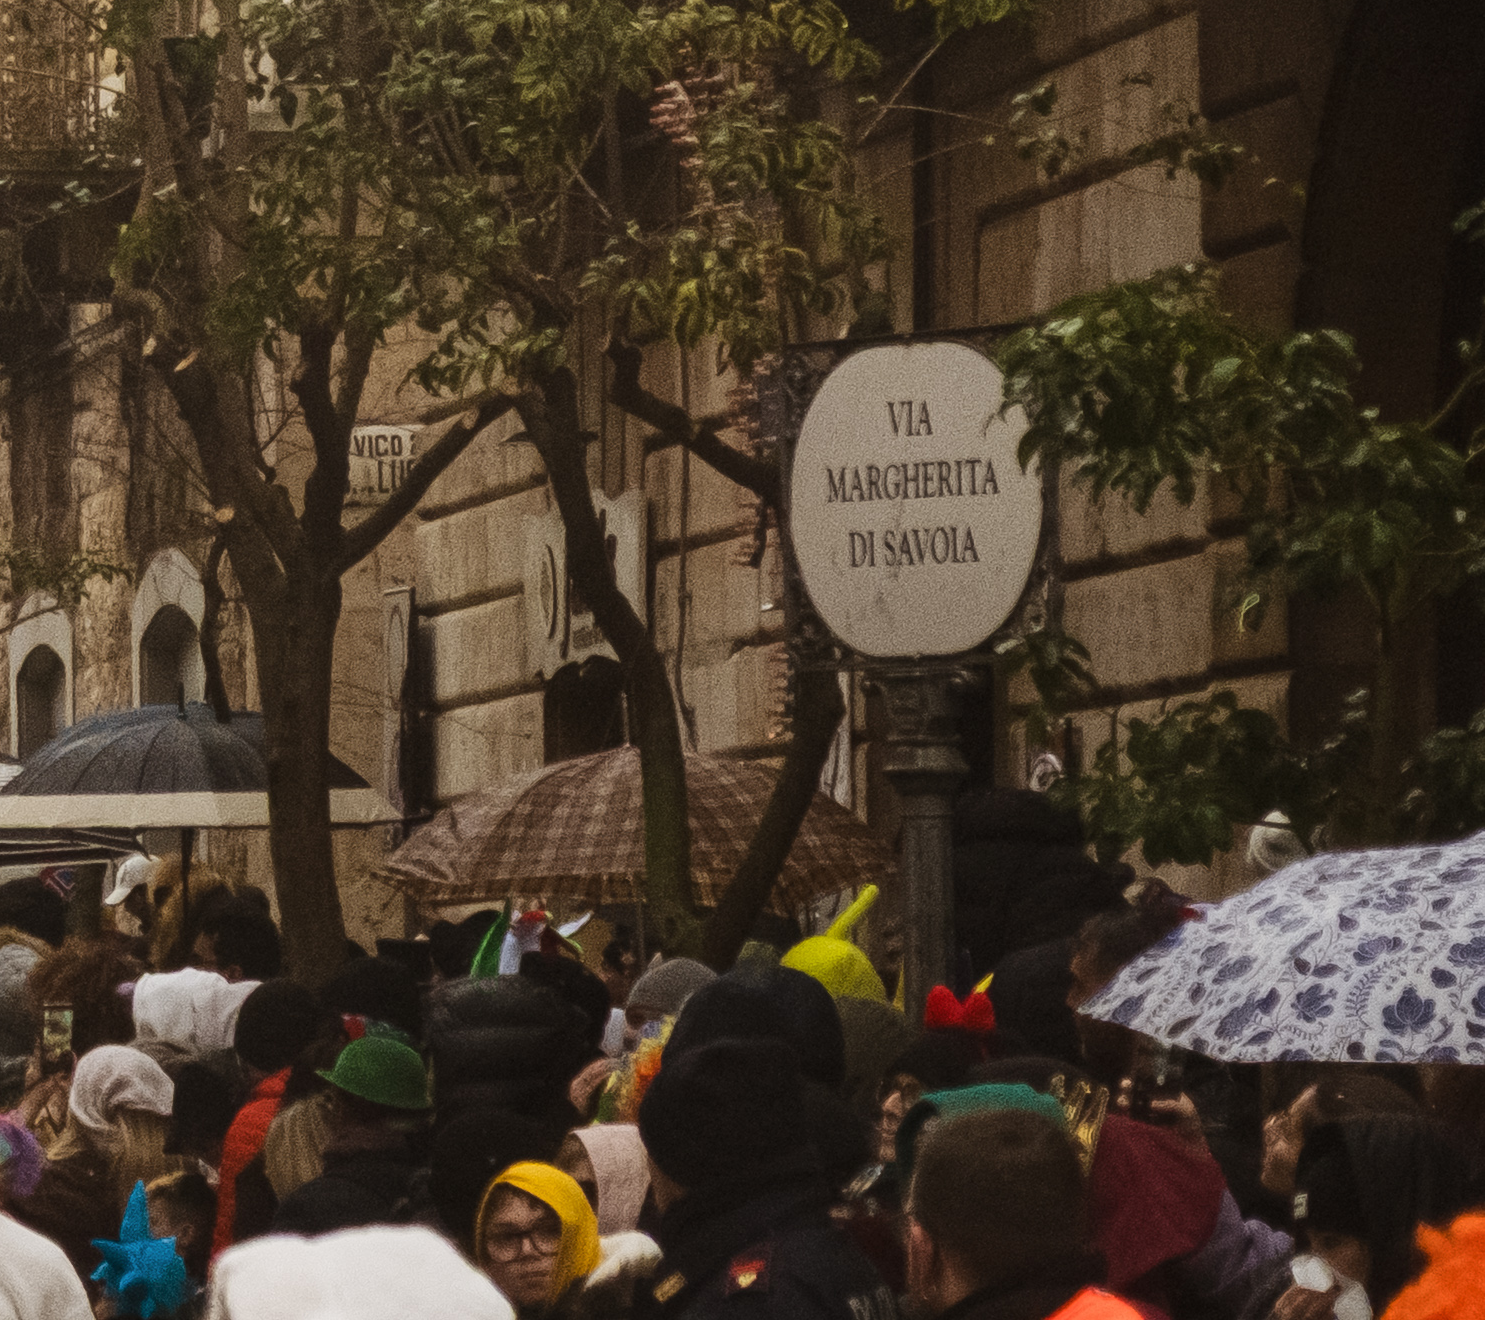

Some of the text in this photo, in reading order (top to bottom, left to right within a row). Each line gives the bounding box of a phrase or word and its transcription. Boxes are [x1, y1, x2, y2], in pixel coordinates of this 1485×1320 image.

[886, 400, 933, 437] VIA
[354, 434, 403, 459] VICO
[827, 458, 1001, 503] MARGHERITA
[849, 526, 979, 568] DI SAVOIA
